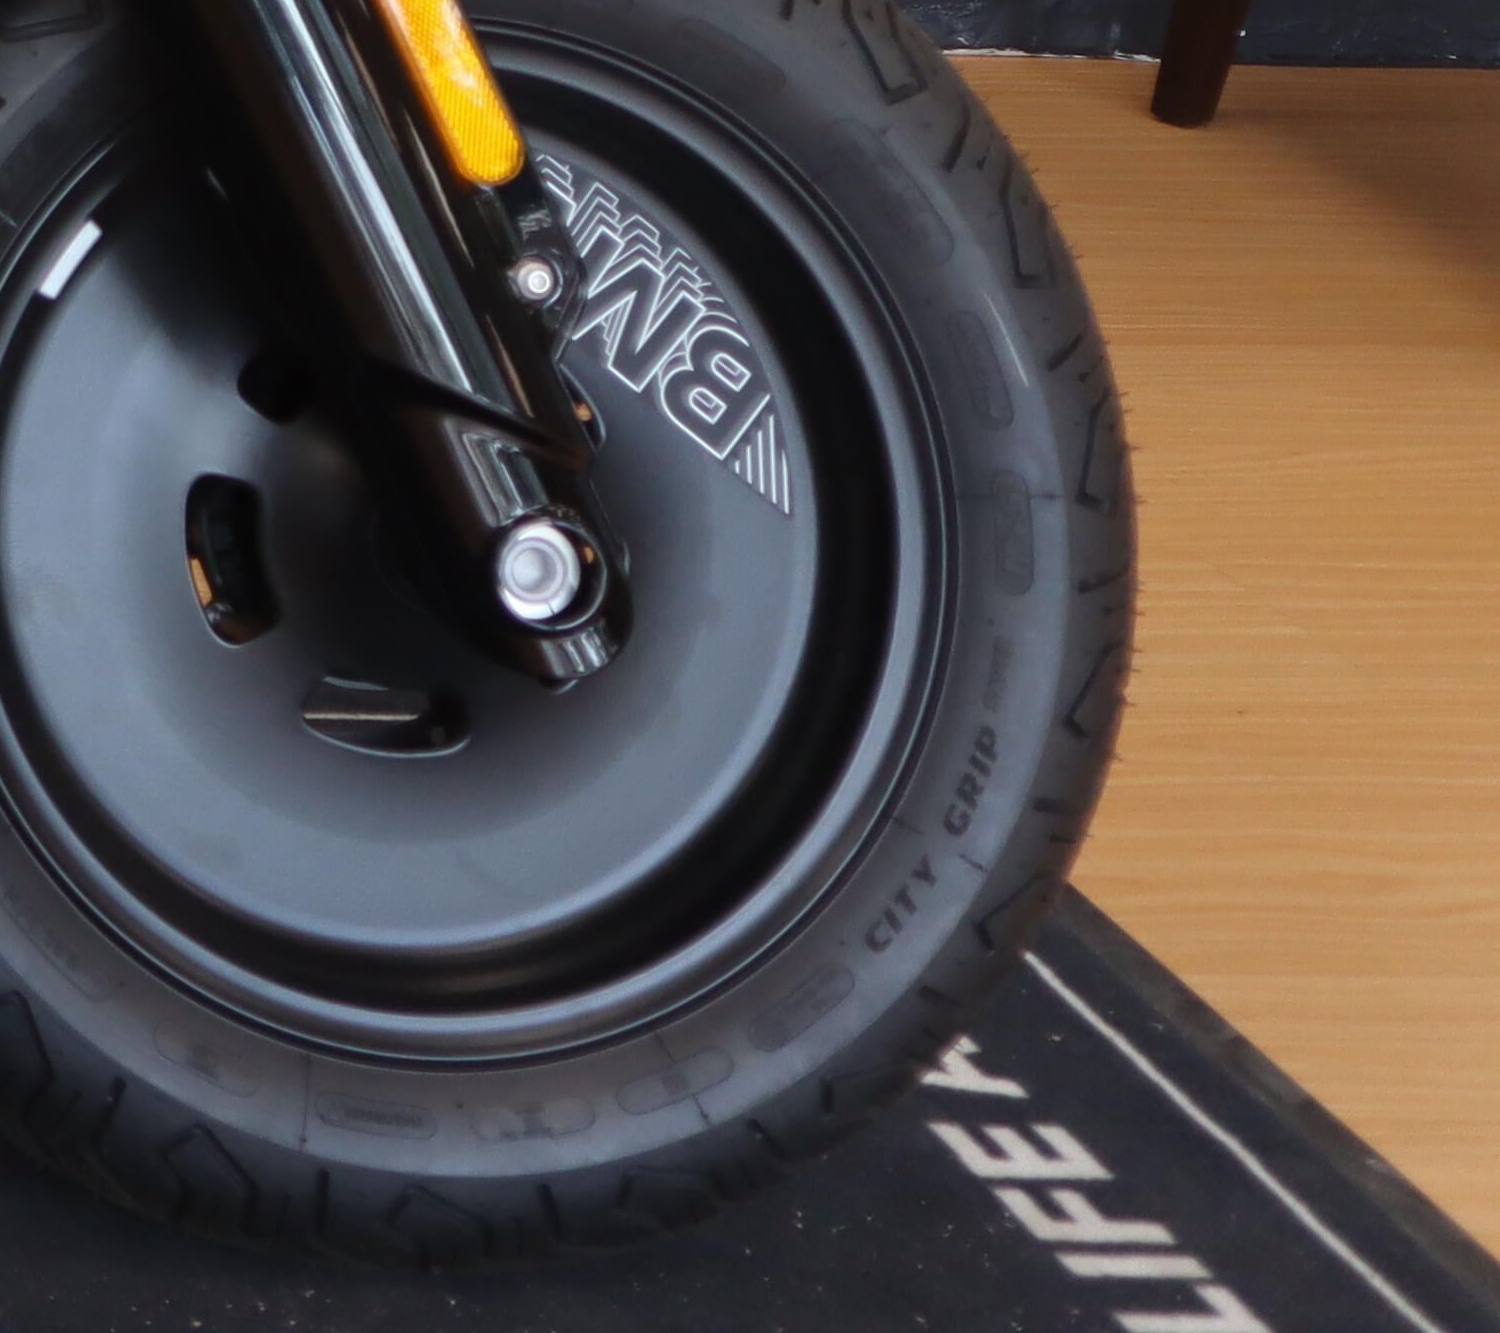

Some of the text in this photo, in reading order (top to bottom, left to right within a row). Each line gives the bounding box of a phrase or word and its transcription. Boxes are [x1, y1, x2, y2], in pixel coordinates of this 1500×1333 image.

[536, 155, 773, 460] BM
[864, 853, 938, 954] CITY
[942, 724, 1001, 837] GRIP
[925, 1121, 1277, 1333] LIFE
